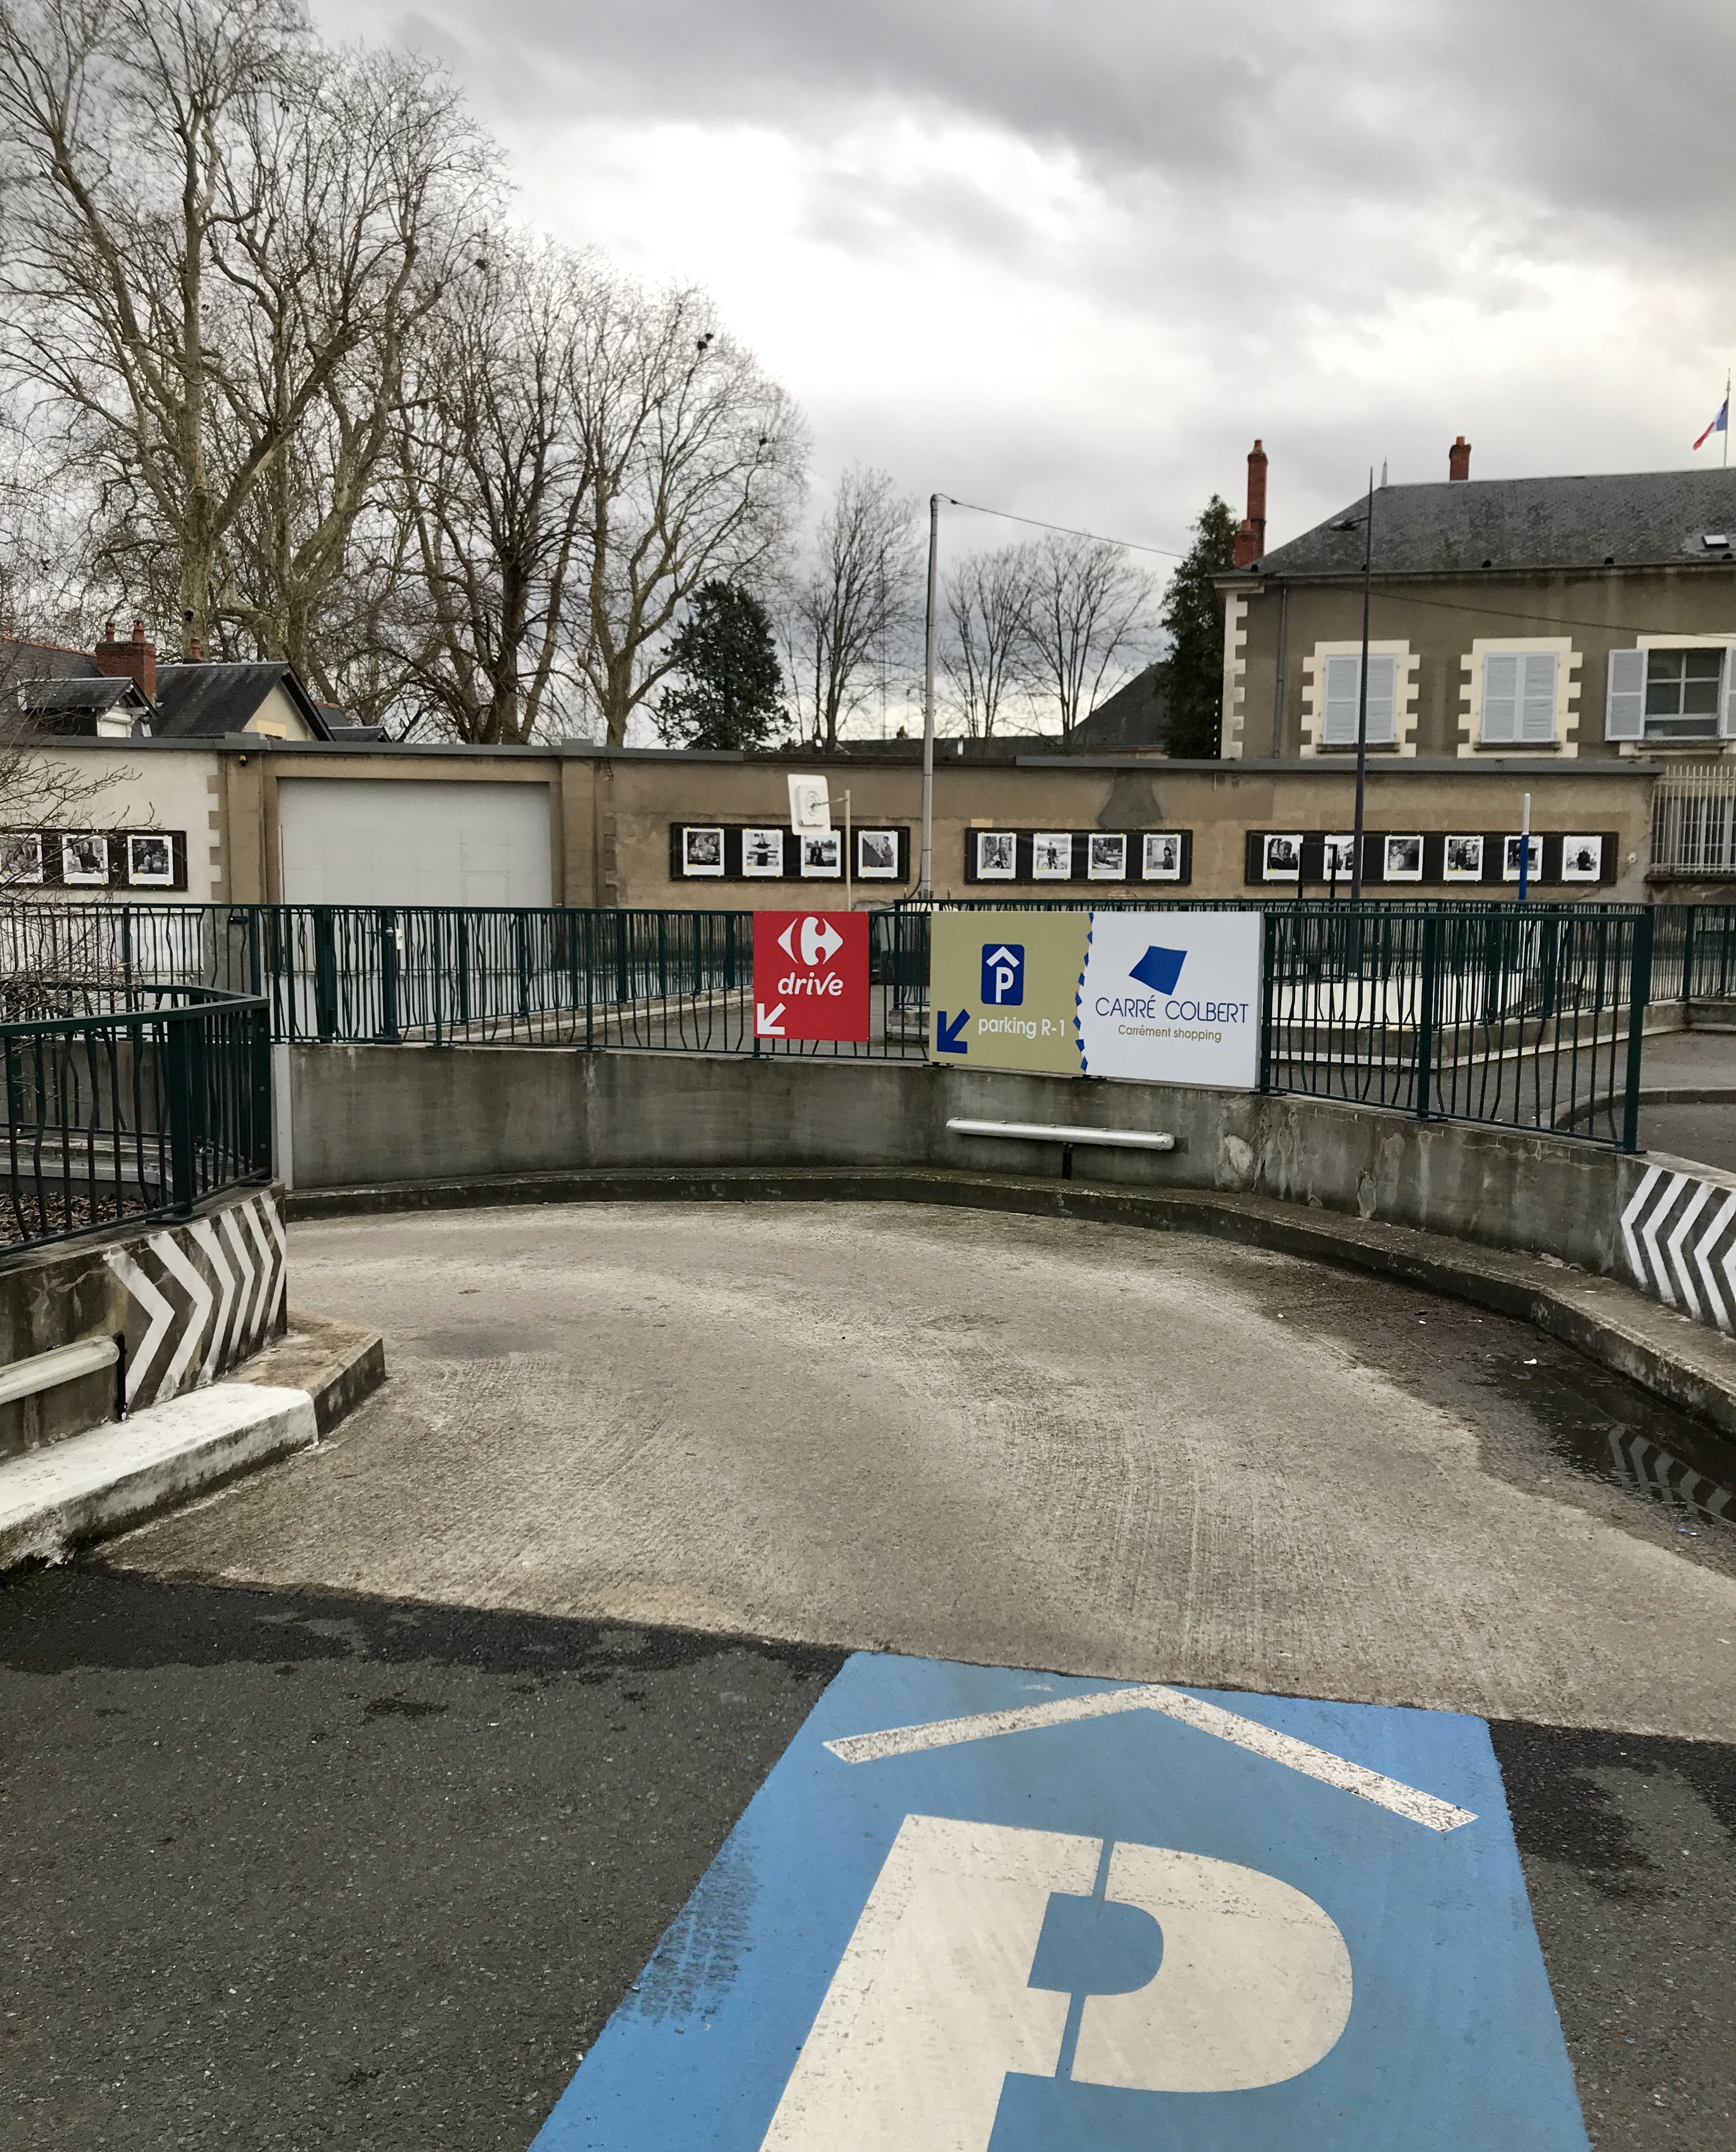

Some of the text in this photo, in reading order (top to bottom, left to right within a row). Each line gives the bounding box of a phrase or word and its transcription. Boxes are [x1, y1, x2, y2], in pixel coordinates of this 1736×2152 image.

[778, 972, 843, 996] drive
[995, 966, 1014, 1003] P
[1095, 995, 1249, 1023] CARRÉ COLBERT
[979, 1016, 1065, 1039] parking R-1
[1118, 1024, 1222, 1043] Carrément shopping
[759, 1814, 1353, 2152] P
